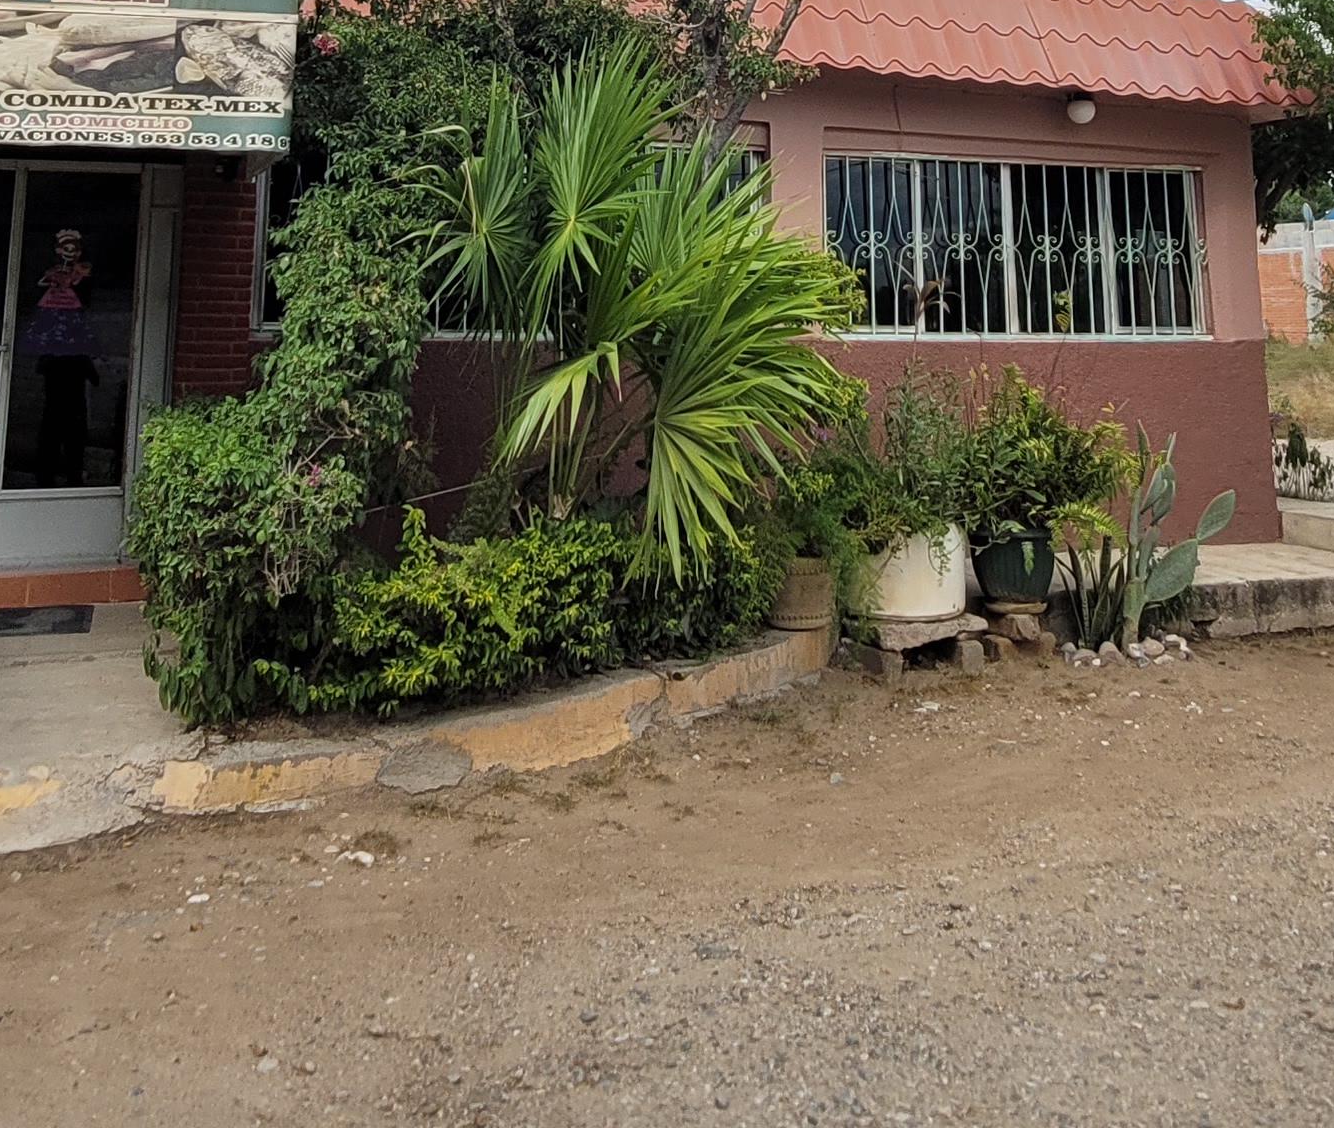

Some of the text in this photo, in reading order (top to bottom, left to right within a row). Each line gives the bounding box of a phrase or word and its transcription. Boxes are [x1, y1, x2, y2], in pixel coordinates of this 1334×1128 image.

[3, 93, 134, 109] COMIDA
[142, 97, 283, 115] TEX-MEX
[25, 115, 43, 129] A
[47, 116, 190, 130] DOMICILIO
[140, 133, 183, 145] 953
[191, 135, 218, 146] 53
[224, 135, 241, 147] 4
[248, 135, 274, 147] 18
